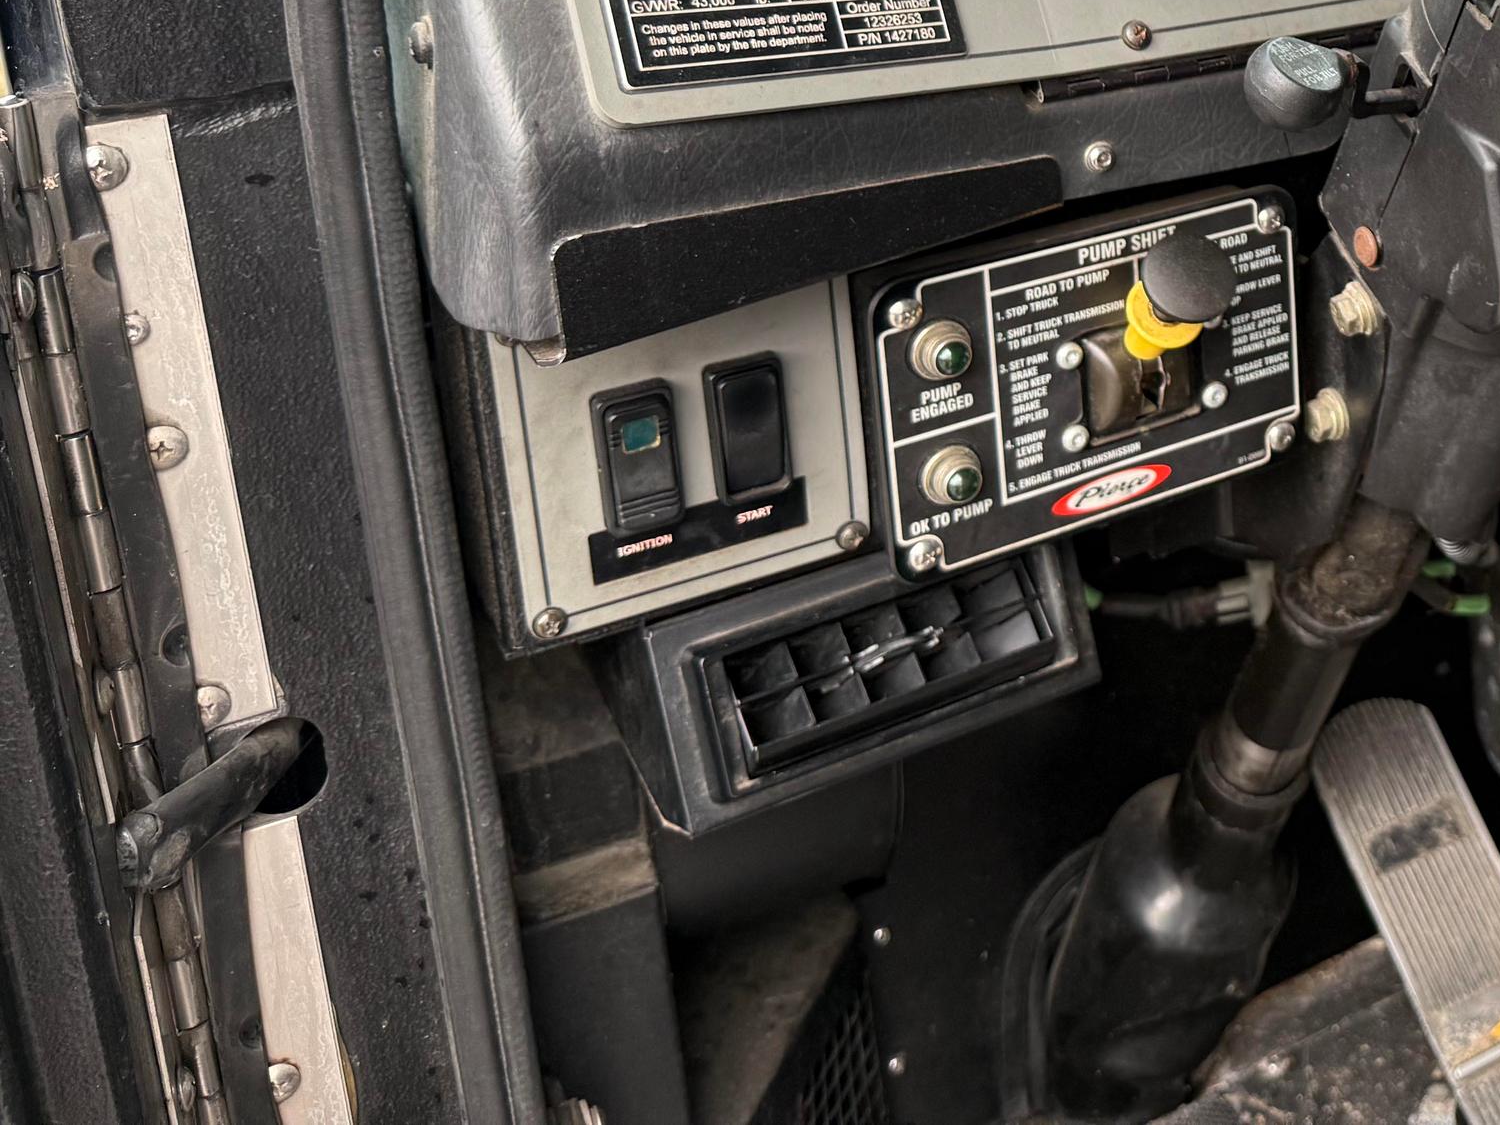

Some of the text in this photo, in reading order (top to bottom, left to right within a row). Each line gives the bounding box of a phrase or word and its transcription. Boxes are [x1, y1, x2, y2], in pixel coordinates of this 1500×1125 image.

[631, 0, 684, 13] GVWR:
[847, 2, 881, 14] Order
[641, 12, 827, 35] Changes in these values after placing
[864, 13, 923, 28] 12326253
[650, 21, 825, 46] the vehicle in service shall be noted
[858, 28, 936, 45] P/N 1427180
[653, 34, 827, 58] on this plate by the fire department.
[1078, 238, 1127, 266] PUMP
[1220, 233, 1248, 250] ROAD
[1025, 269, 1110, 302] ROAD TO PUMP
[995, 297, 1059, 322] 1. STOP TRUCK
[997, 299, 1125, 342] 2. SHIFT TRUCK TRANSMISSION
[1008, 329, 1060, 351] TO NEUTRAL
[1000, 352, 1049, 374] 3. SET PARK
[1010, 366, 1039, 382] BRAKE
[920, 382, 962, 405] PUMP
[1011, 374, 1052, 393] AND KEEP
[1012, 387, 1048, 404] SERVICE
[910, 393, 974, 424] ENGAGED
[1013, 400, 1041, 416] BRAKE
[1013, 409, 1049, 427] APPLIED
[1015, 429, 1047, 446] THROW
[1016, 442, 1043, 458] LEVER
[1008, 442, 1142, 492] 5. ENGAGE TRUCK TRANSMISSION
[1017, 453, 1044, 470] DOWN
[1075, 473, 1150, 508] Pierce
[736, 505, 773, 524] START
[910, 498, 993, 537] OK TO PUMP
[617, 534, 673, 558] IGNITION
